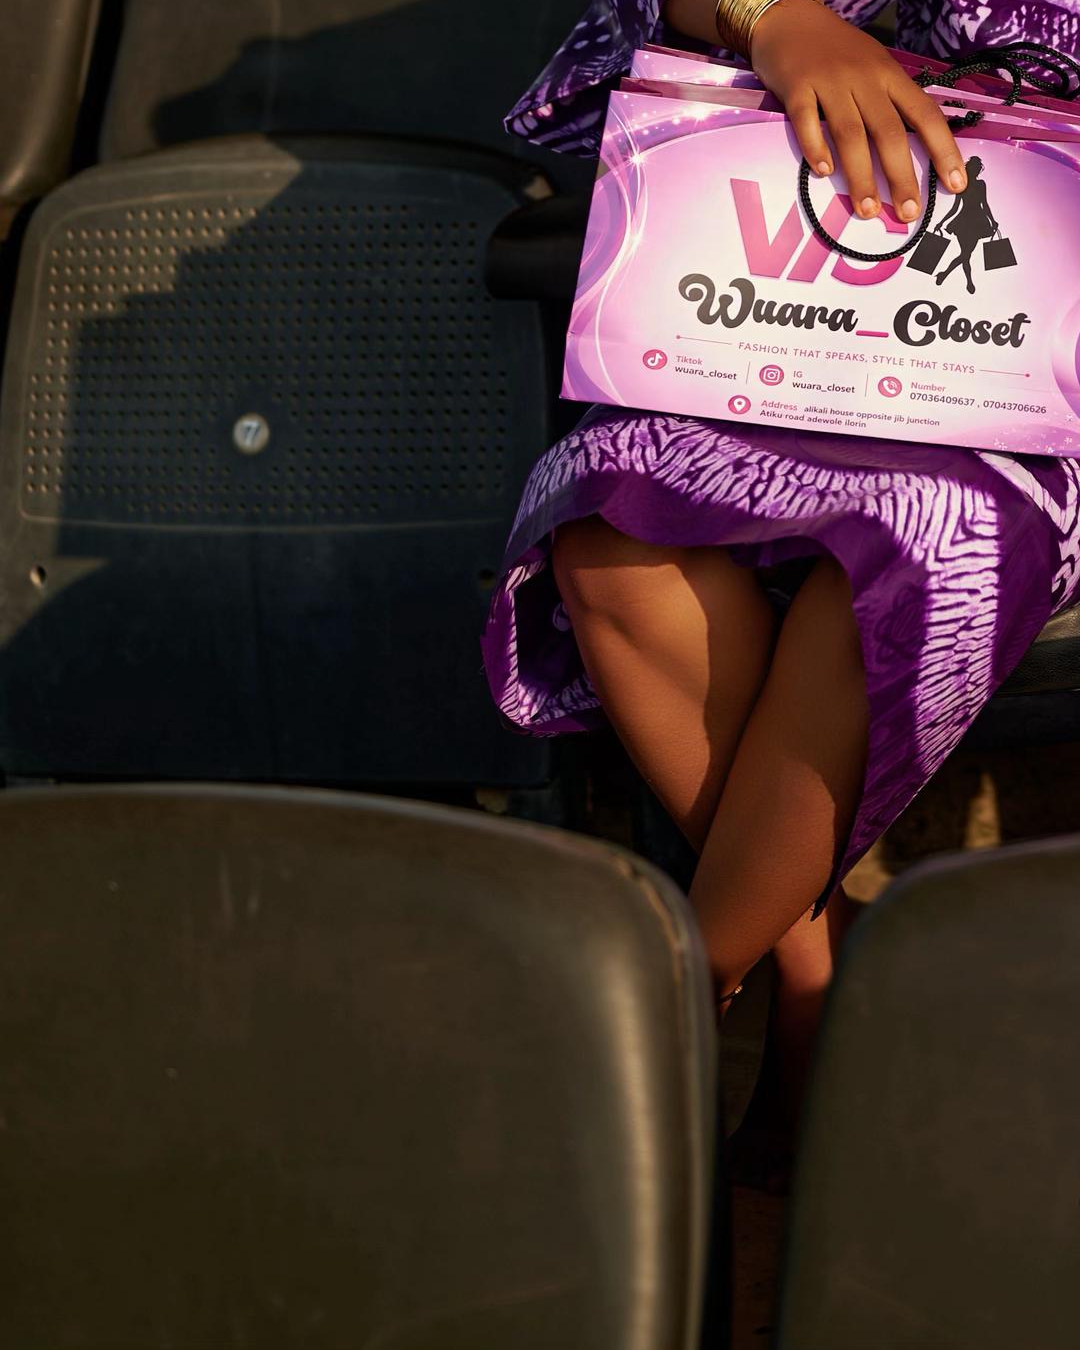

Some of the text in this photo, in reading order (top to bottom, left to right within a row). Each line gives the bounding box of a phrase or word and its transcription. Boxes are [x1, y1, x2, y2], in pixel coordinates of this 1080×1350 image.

[675, 354, 703, 366] Tiktok
[738, 341, 976, 374] FASHION THAT SPEAKS, STYLE THAT STAYS
[674, 365, 738, 381] wuara_closet
[793, 370, 803, 379] IG
[792, 381, 856, 394] wuara_closet
[911, 381, 946, 393] Number
[761, 400, 798, 412] Address
[804, 406, 828, 415] alikali
[829, 407, 854, 417] house
[856, 411, 892, 421] opposite
[906, 415, 940, 427] junction
[983, 400, 1047, 415] 07043706626
[760, 409, 867, 428] Atiku road adewole ilorin
